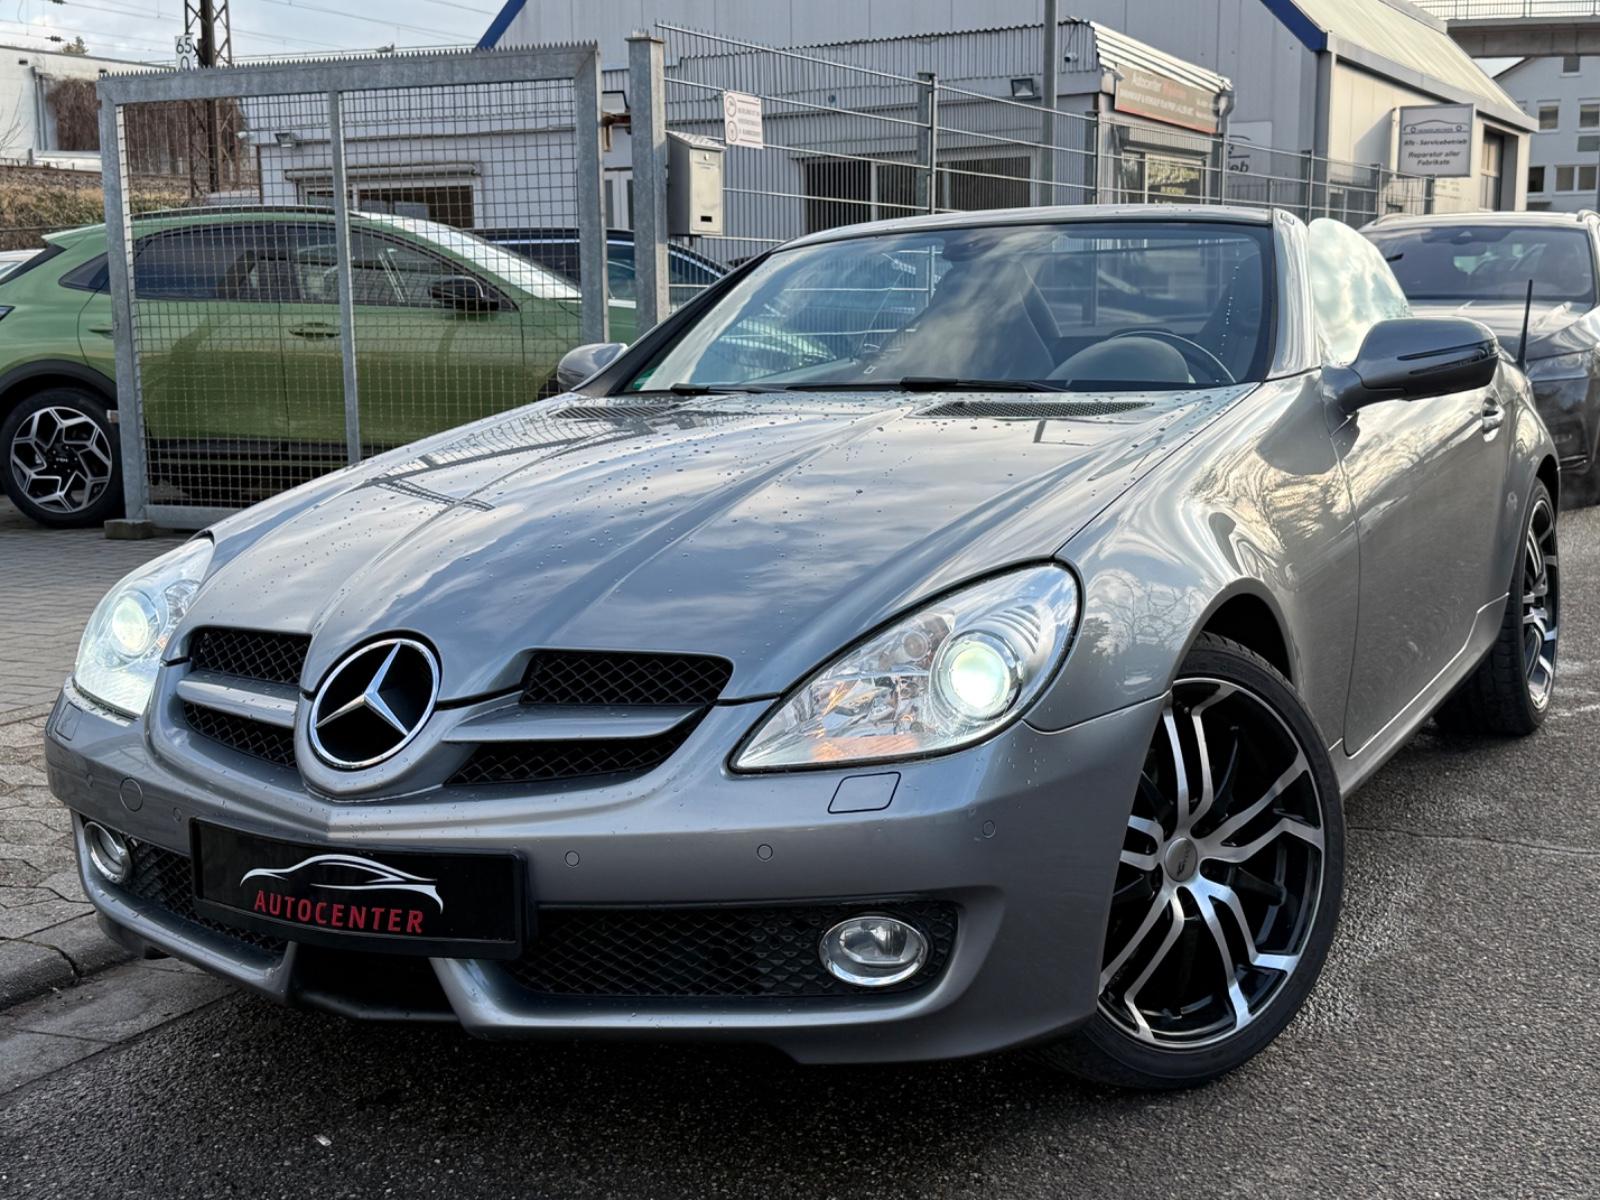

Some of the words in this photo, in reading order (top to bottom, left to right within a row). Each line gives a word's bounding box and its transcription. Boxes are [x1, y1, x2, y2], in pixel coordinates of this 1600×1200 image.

[176, 36, 192, 54] 65
[180, 55, 190, 70] 0
[1420, 138, 1468, 147] Servicebetrieb
[1408, 151, 1443, 159] Reparatur
[1444, 150, 1461, 158] aller
[1417, 159, 1451, 167] Fabrikate
[254, 889, 424, 934] AUTOCENTER
